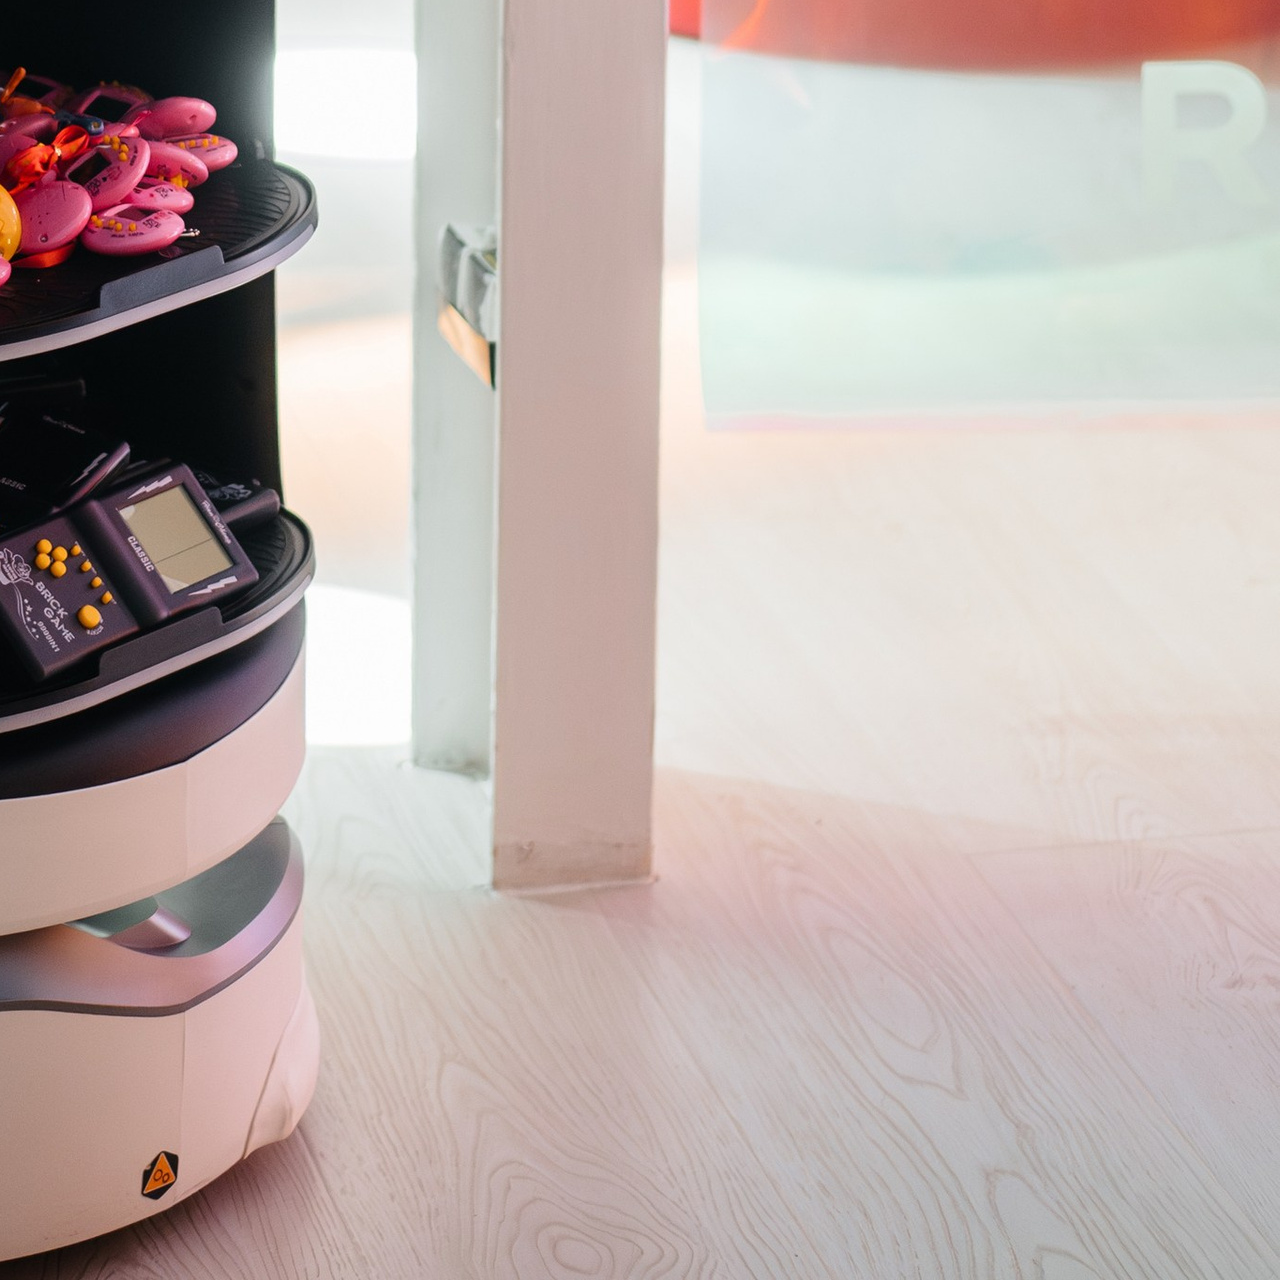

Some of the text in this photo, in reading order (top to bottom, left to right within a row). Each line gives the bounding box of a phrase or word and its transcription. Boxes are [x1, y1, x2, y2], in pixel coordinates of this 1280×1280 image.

[126, 535, 155, 573] CLASSIC
[34, 580, 70, 621] BRICK
[43, 606, 76, 644] GAME
